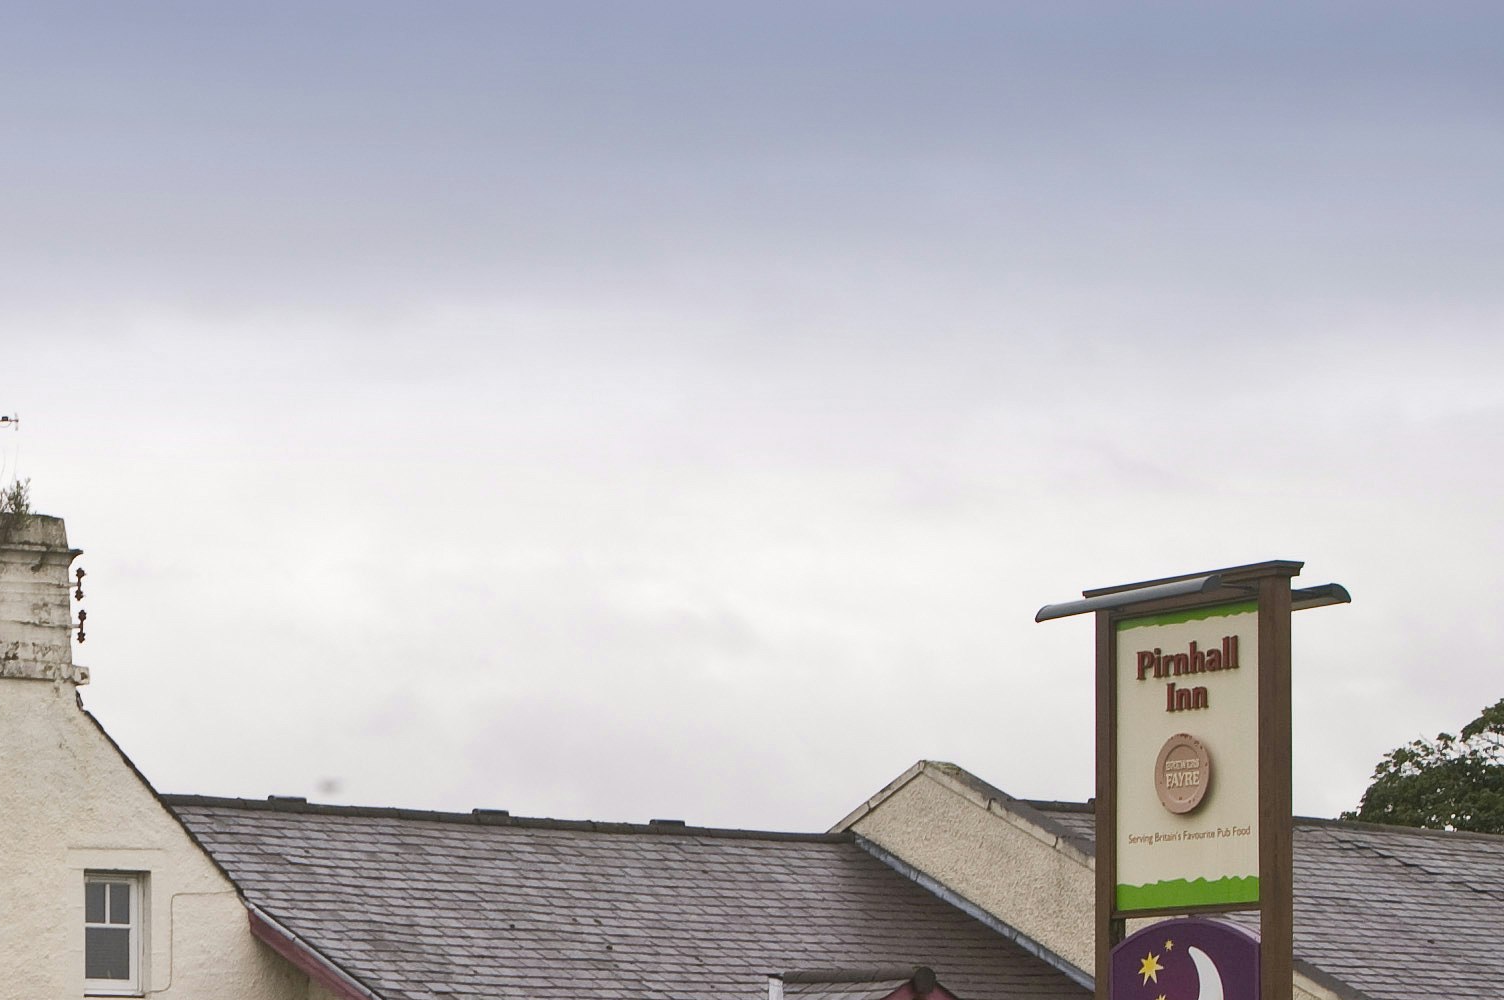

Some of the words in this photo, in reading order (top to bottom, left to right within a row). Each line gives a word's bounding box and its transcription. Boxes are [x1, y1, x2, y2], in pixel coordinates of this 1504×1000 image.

[1136, 635, 1240, 681] Pirnhall
[1166, 682, 1209, 712] Inn
[1165, 771, 1200, 788] FAYRE
[1128, 834, 1153, 845] Serving
[1154, 831, 1182, 843] Britain's
[1183, 830, 1216, 841] Favourite
[1217, 828, 1231, 838] Pub
[1232, 825, 1251, 837] Food
